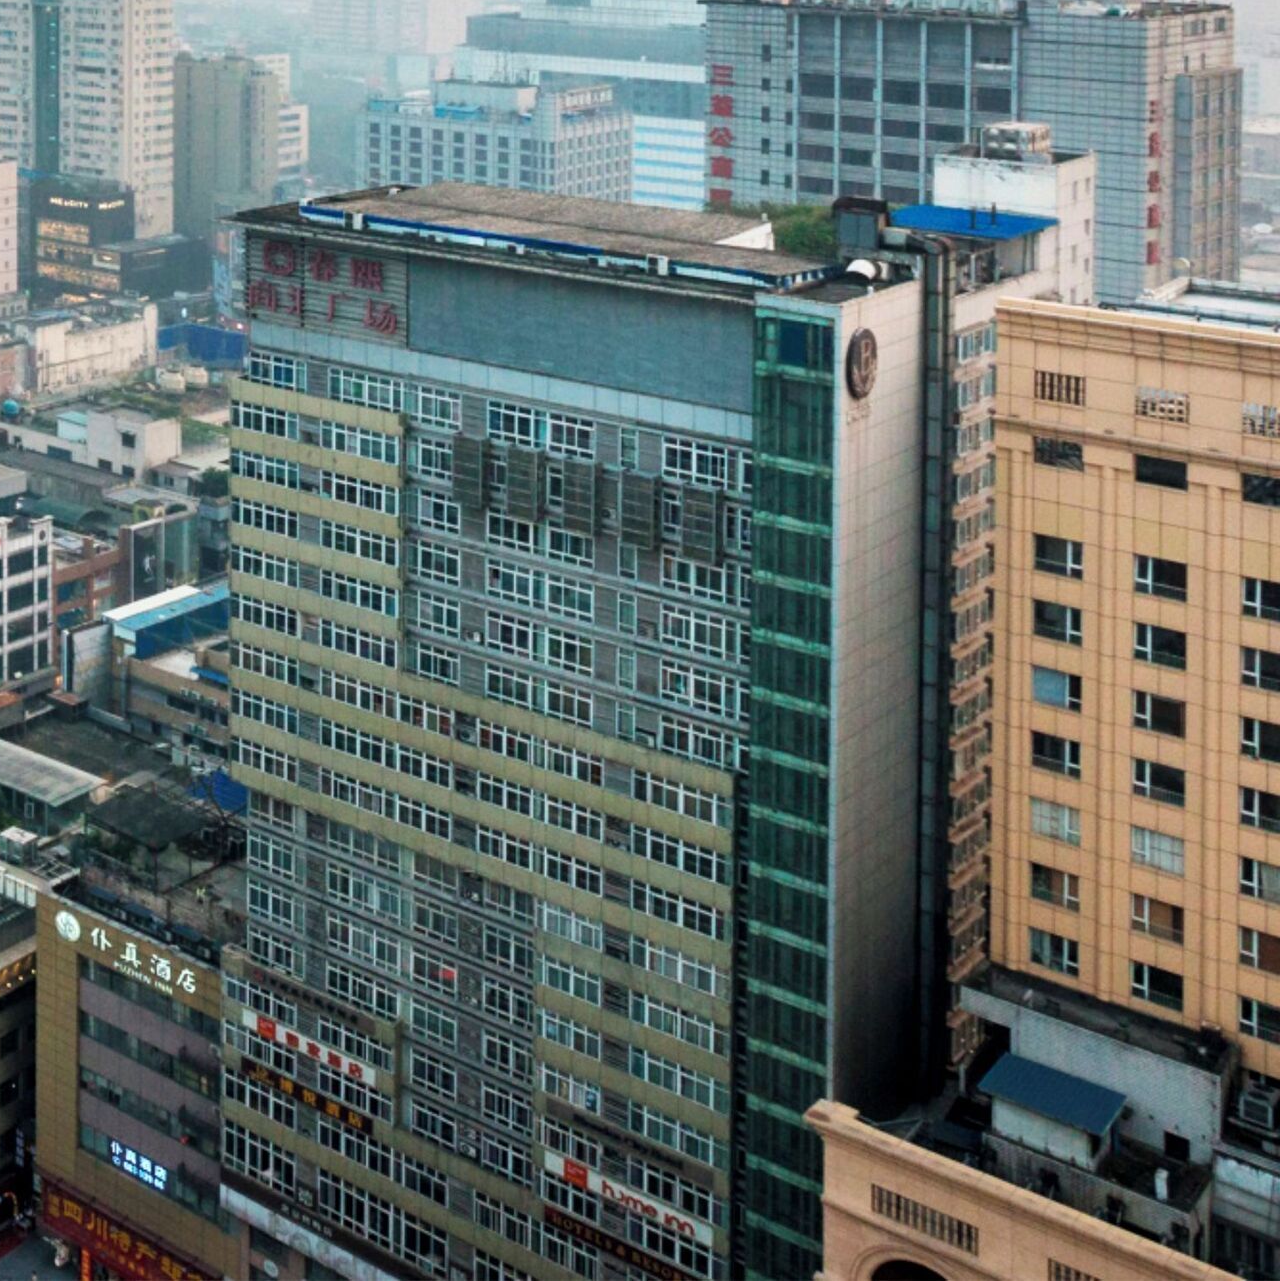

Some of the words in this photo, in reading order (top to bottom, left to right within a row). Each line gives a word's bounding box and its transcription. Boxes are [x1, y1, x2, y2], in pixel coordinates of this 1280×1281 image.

[310, 248, 383, 293] 春熙
[91, 927, 197, 995] 仆真酒店
[113, 960, 152, 985] PUZHEN
[154, 980, 174, 996] INN
[601, 1180, 659, 1219] home
[664, 1212, 696, 1248] inn
